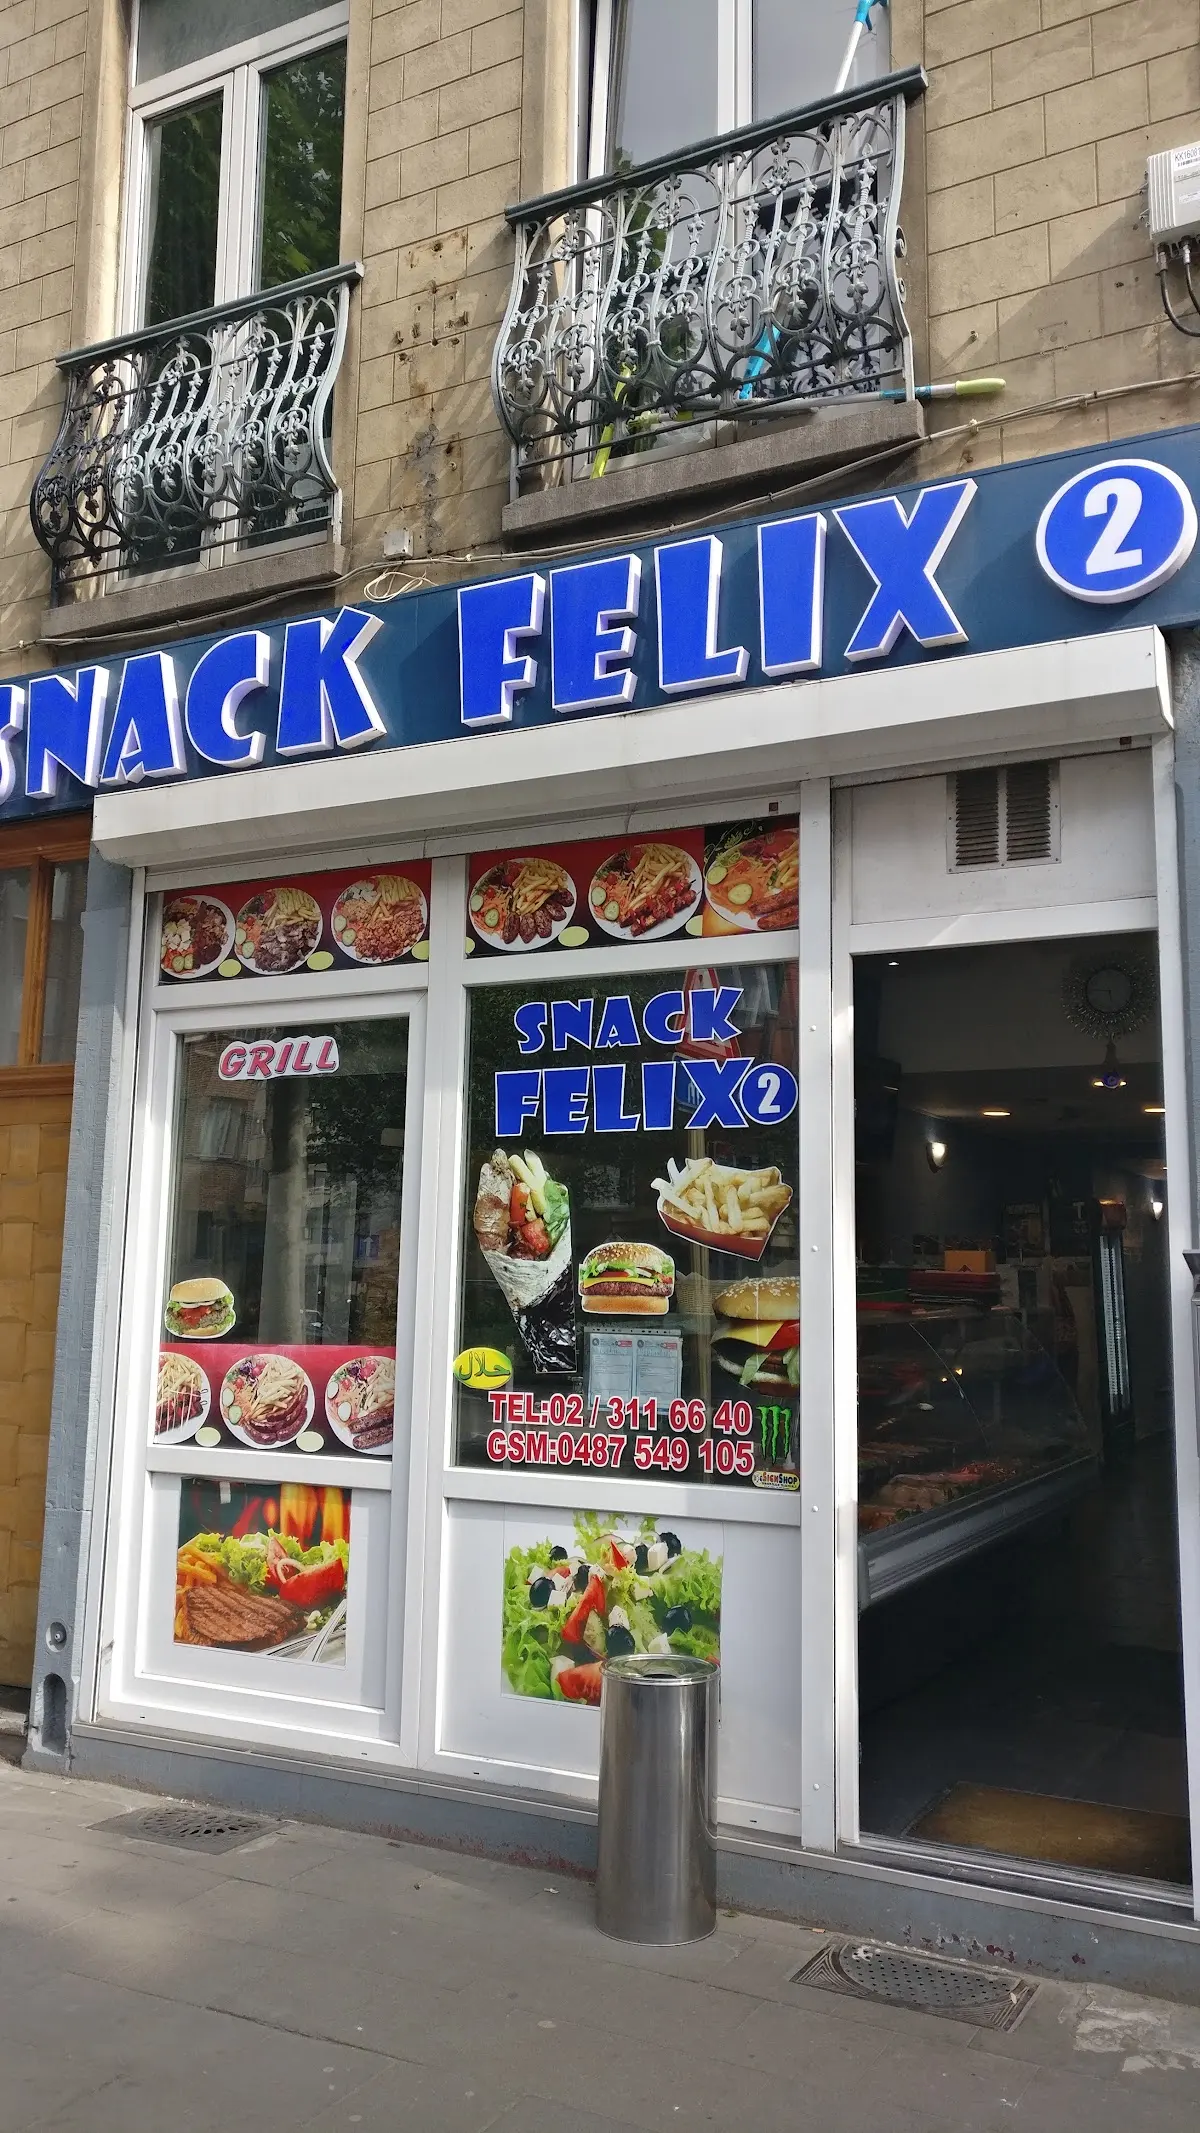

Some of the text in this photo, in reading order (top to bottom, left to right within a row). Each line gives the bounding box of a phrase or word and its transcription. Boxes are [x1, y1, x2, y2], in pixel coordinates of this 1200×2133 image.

[457, 478, 978, 728] FELIX
[1083, 477, 1143, 574] 2
[514, 986, 745, 1054] SNACK
[220, 1037, 338, 1079] GRILL
[495, 1057, 755, 1137] FELIX
[458, 1350, 511, 1381] حلال
[488, 1391, 584, 1427] TEL:02
[606, 1396, 658, 1431] 311
[668, 1399, 706, 1434] 66
[713, 1400, 753, 1437] 40
[487, 1430, 755, 1477] GSM:0487 549 105
